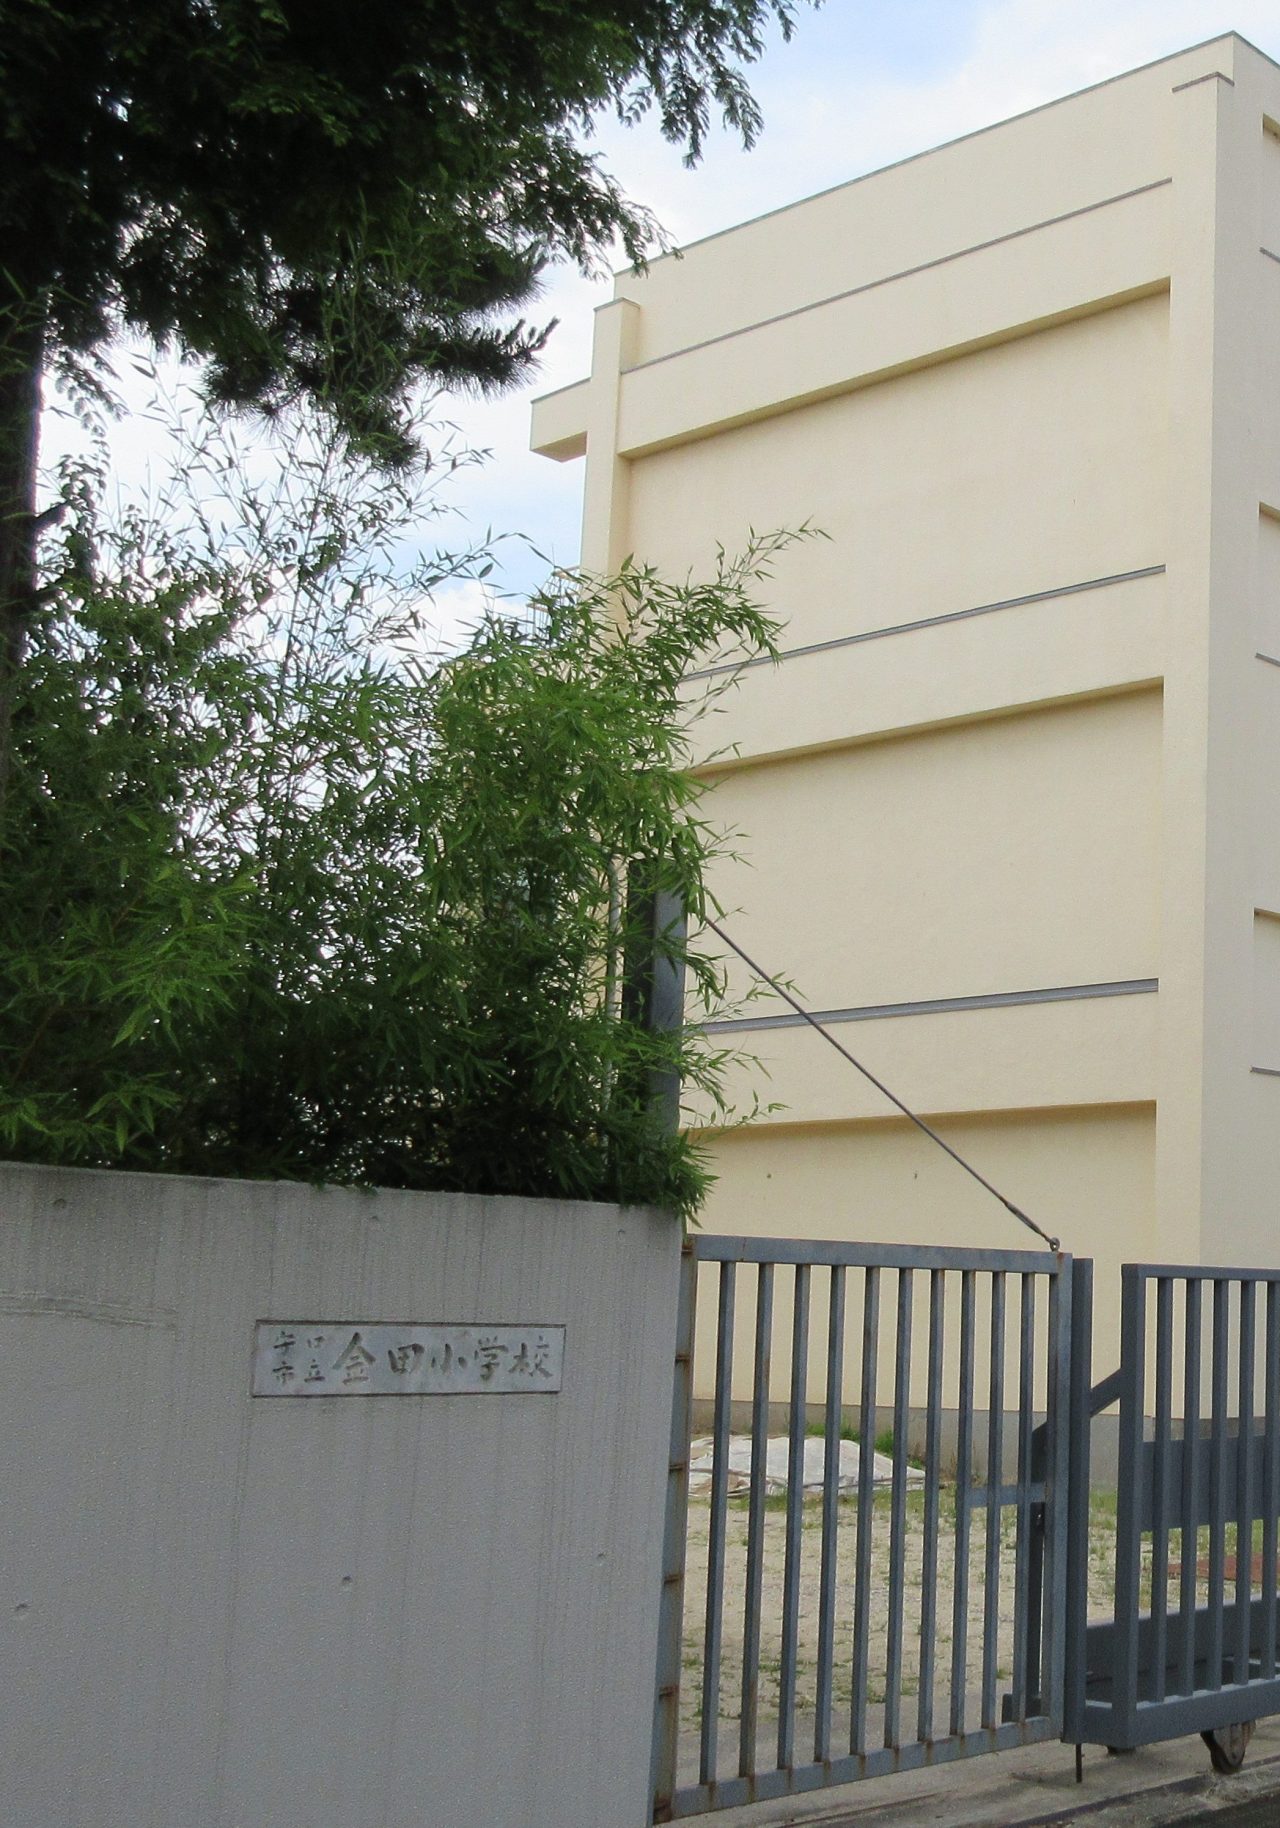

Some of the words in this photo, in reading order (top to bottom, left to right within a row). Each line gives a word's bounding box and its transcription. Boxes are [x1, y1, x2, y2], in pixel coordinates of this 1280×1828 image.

[271, 1359, 326, 1385] 市立
[331, 1332, 553, 1386] 金田小学校
